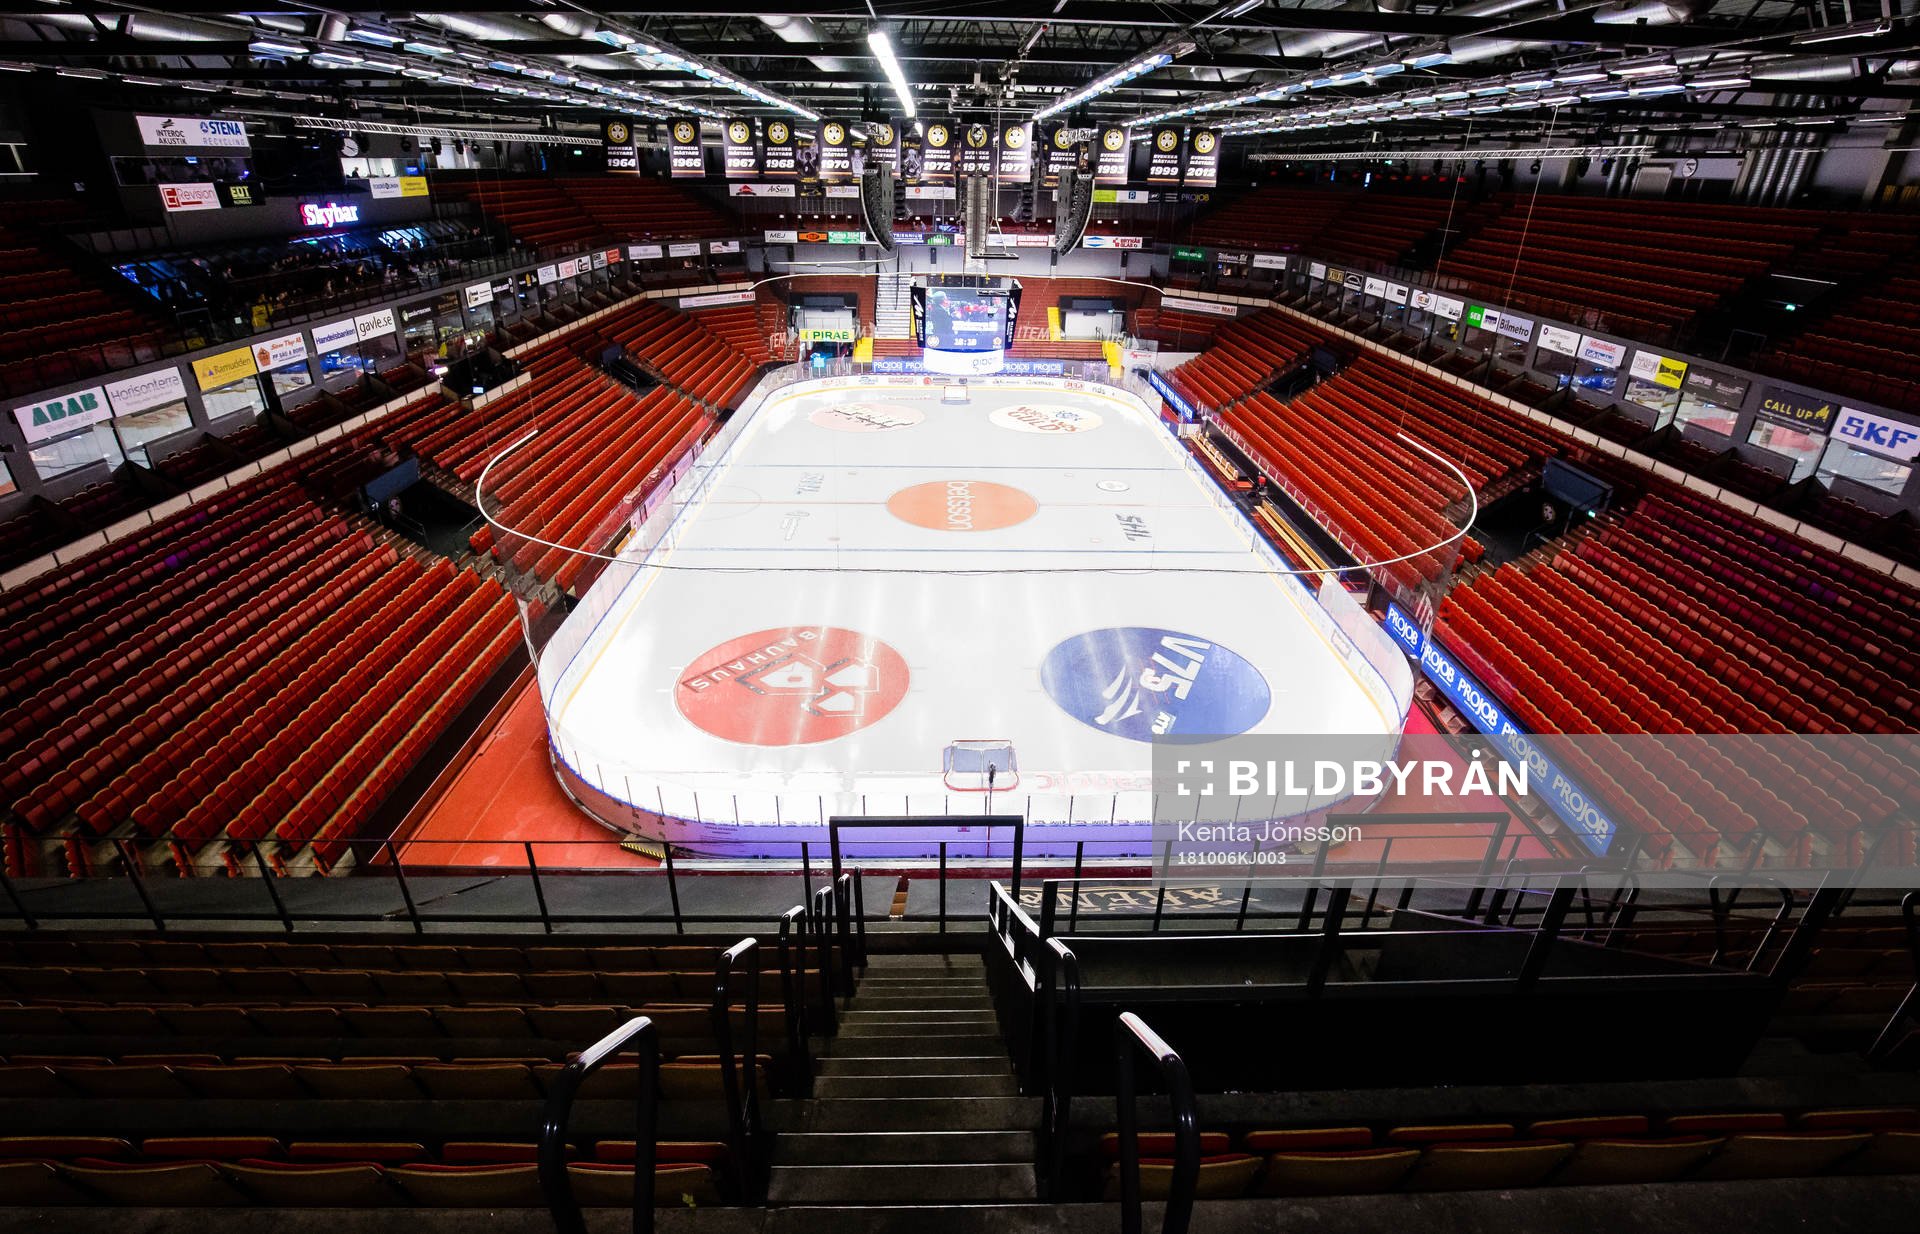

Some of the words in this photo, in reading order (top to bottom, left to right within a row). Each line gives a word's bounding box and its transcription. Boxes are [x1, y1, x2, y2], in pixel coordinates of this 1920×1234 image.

[156, 129, 186, 138] INTEROC
[208, 121, 242, 135] STENA
[158, 137, 188, 145] AKUSTIK
[202, 137, 246, 146] RECYCLING
[608, 158, 636, 167] 1964
[672, 158, 701, 167] 1966
[727, 158, 756, 168] 1967
[765, 159, 795, 168] 1968
[820, 160, 850, 169] 1970
[923, 161, 952, 171] 1972
[1000, 163, 1028, 171] 1977
[1150, 166, 1179, 176] 1999
[1186, 167, 1216, 177] 2012
[177, 187, 217, 201] Revision
[1181, 193, 1210, 202] PROJOB
[301, 202, 359, 229] Skybar
[359, 314, 393, 336] gavle.se
[1470, 311, 1482, 321] SEB
[315, 327, 356, 346] Handelsbanken
[1500, 318, 1530, 337] Bilmetro
[213, 356, 251, 376] Ramudden
[110, 375, 180, 402] Horisonterra
[32, 392, 99, 427] ABAB
[1764, 399, 1791, 415] CALL
[1796, 408, 1813, 420] UP
[1839, 415, 1918, 449] SKF
[947, 480, 977, 530] betsson
[1387, 606, 1419, 646] PROJOB
[690, 630, 818, 691] BAUHAUS
[1139, 635, 1212, 701] V75
[1420, 640, 1456, 683] PROJOB
[1457, 678, 1499, 727] PROJOB
[1501, 721, 1549, 779] PROJOB
[1551, 774, 1609, 840] PROJOB
